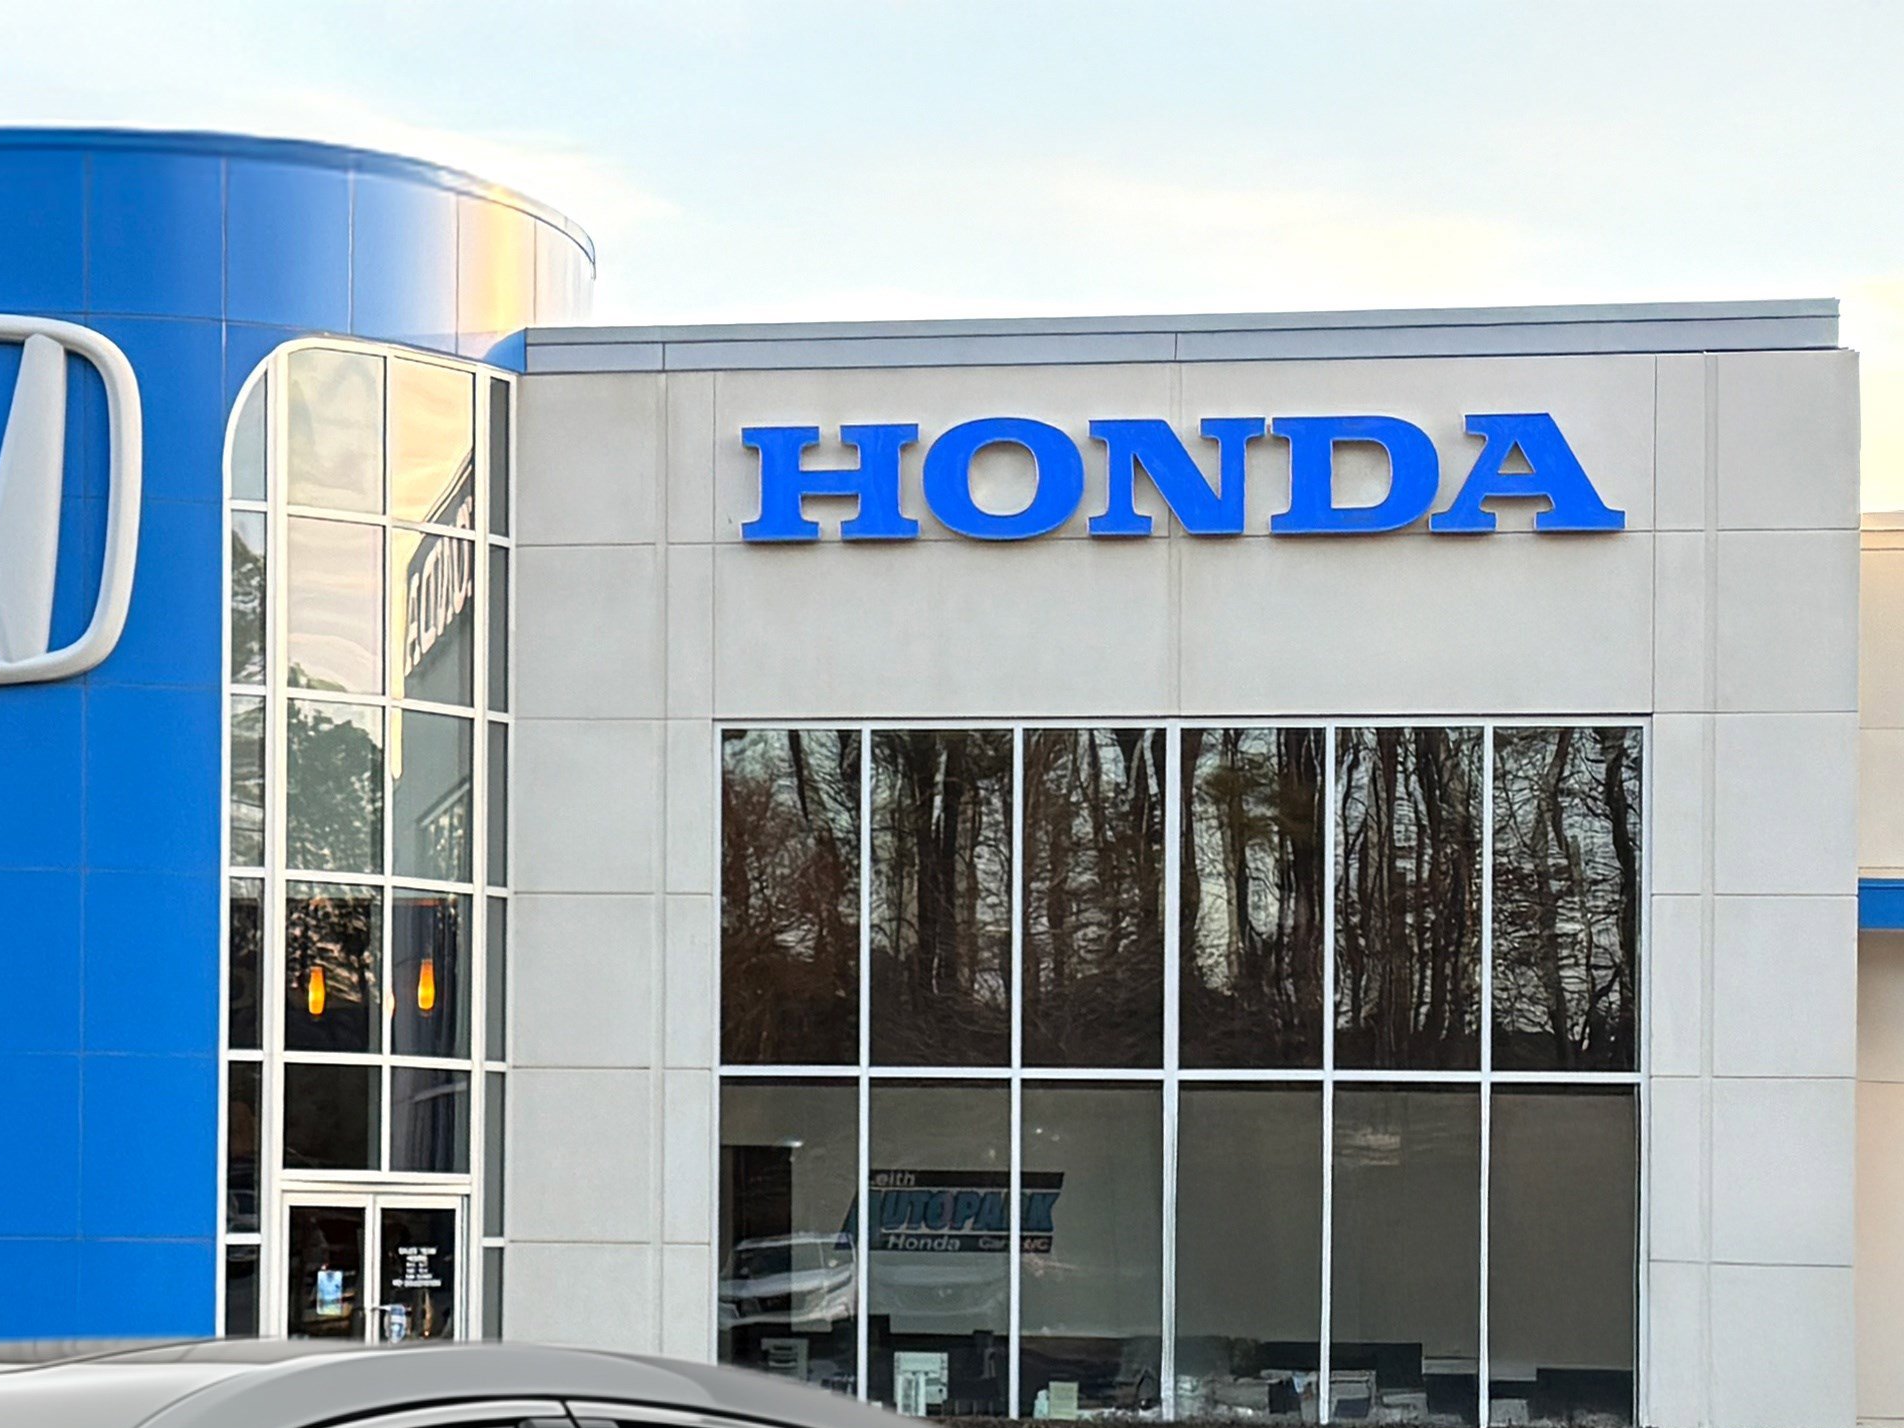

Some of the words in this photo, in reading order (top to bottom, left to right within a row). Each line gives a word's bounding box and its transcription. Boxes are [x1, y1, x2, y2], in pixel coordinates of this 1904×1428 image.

[740, 411, 1627, 542] HONDA
[870, 1171, 915, 1186] eith
[887, 1234, 960, 1250] Honda
